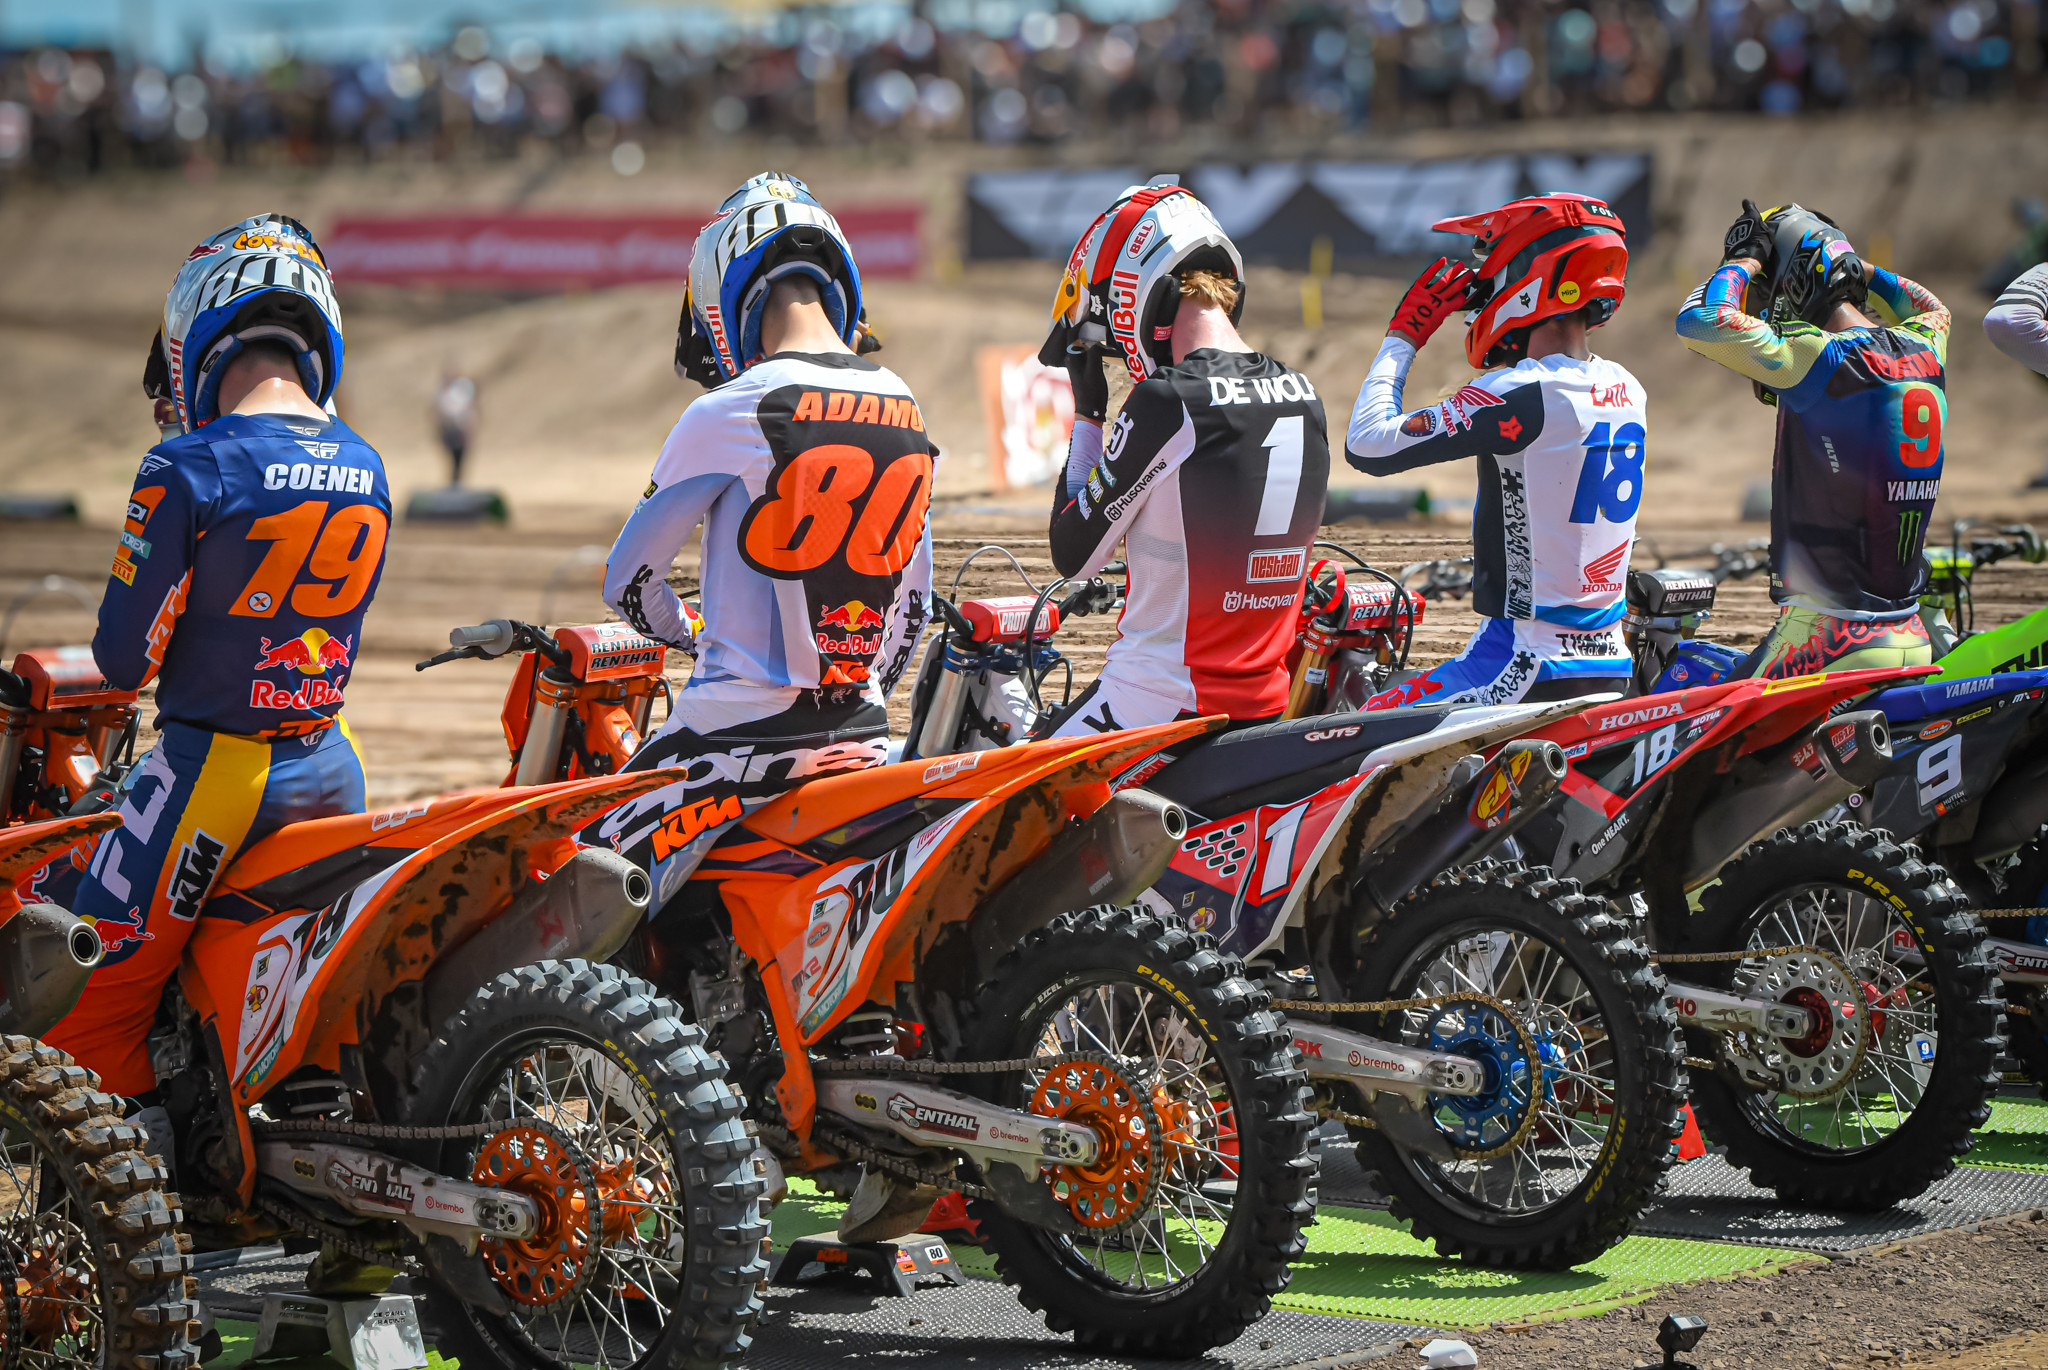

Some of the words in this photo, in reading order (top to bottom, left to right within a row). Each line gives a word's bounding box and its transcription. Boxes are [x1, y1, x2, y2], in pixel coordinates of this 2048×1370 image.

[1591, 203, 1613, 218] FOX
[1129, 223, 1154, 255] BELL
[1112, 270, 1139, 331] Bull
[1560, 287, 1578, 299] Mips
[706, 305, 728, 351] Bull
[1209, 376, 1251, 407] DE
[1900, 388, 1942, 468] 9
[263, 463, 375, 496] COENEN
[1119, 460, 1167, 511] Husqvarna
[1254, 415, 1304, 536] 1
[1569, 421, 1646, 524] 18
[1887, 479, 1940, 502] YAMAHA
[745, 444, 933, 577] 80
[228, 500, 388, 618] 19
[1250, 553, 1302, 579] nestaan
[1582, 583, 1623, 592] HONDA
[1664, 578, 1714, 591] RENTHAL
[1665, 590, 1712, 603] RENTHAL
[816, 633, 850, 655] Red
[851, 633, 882, 656] Bull
[591, 652, 661, 670] RENTHAL
[250, 679, 309, 710] Red
[1945, 678, 1995, 699] YAMAHA
[1599, 702, 1685, 731] HONDA
[1691, 709, 1721, 728] MOTUL
[1304, 726, 1361, 742] GUTS
[1633, 723, 1677, 787] 18
[1917, 734, 1962, 807] 9
[652, 795, 743, 862] KTM
[1592, 838, 1607, 856] One
[1603, 813, 1630, 848] HEART.
[1261, 801, 1310, 898] 1
[170, 831, 225, 919] KTM
[1846, 868, 1935, 953] PIRELLI
[1037, 983, 1062, 1004] EXCEL
[1136, 964, 1218, 1042] PIRELLI
[1363, 1055, 1405, 1073] brembo
[1919, 1041, 1931, 1057] 9
[604, 1039, 675, 1137] PIRELLI
[888, 1096, 978, 1132] RENTHAL
[999, 1130, 1029, 1143] brembo
[1585, 1117, 1626, 1203] DUNLOP
[435, 1200, 465, 1215] brembo
[929, 1247, 943, 1259] 80
